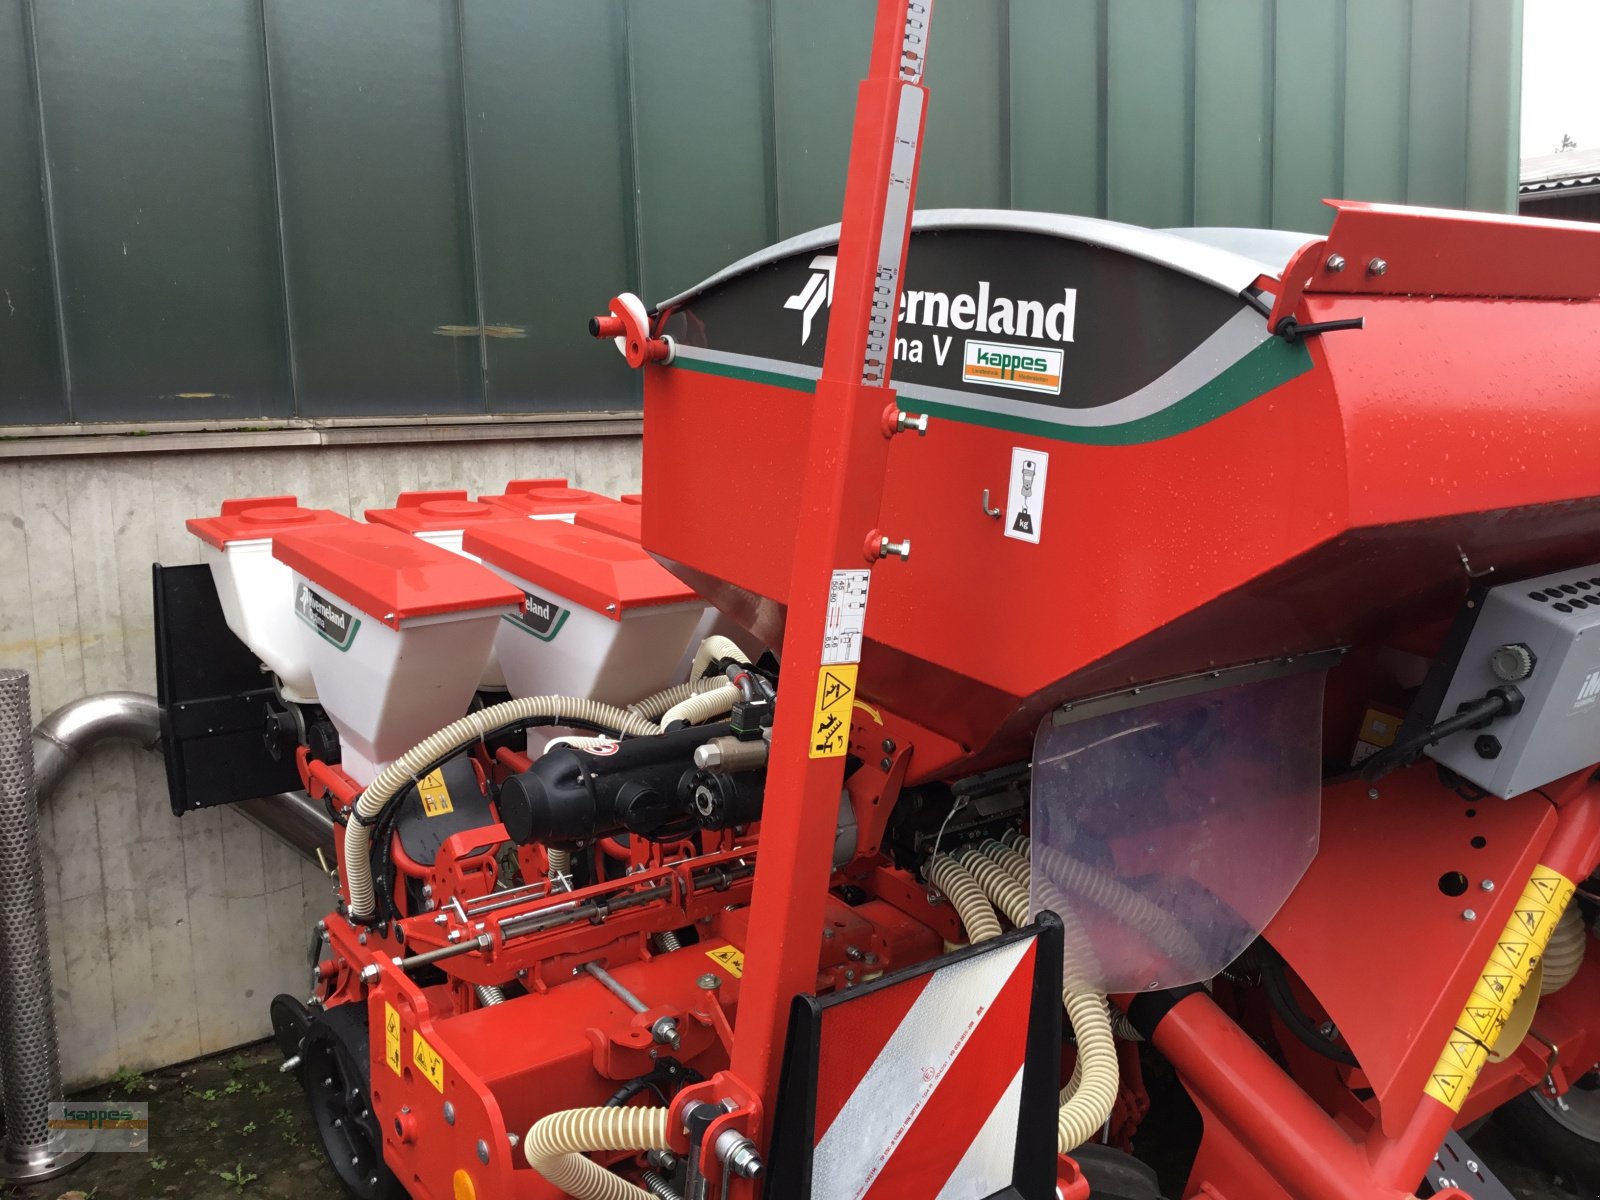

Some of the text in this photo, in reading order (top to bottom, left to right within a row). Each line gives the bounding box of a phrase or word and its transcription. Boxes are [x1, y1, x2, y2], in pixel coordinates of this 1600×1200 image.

[932, 334, 953, 366] V
[977, 347, 1048, 381] kappes
[1019, 518, 1029, 530] kg
[308, 591, 346, 630] Kverneland
